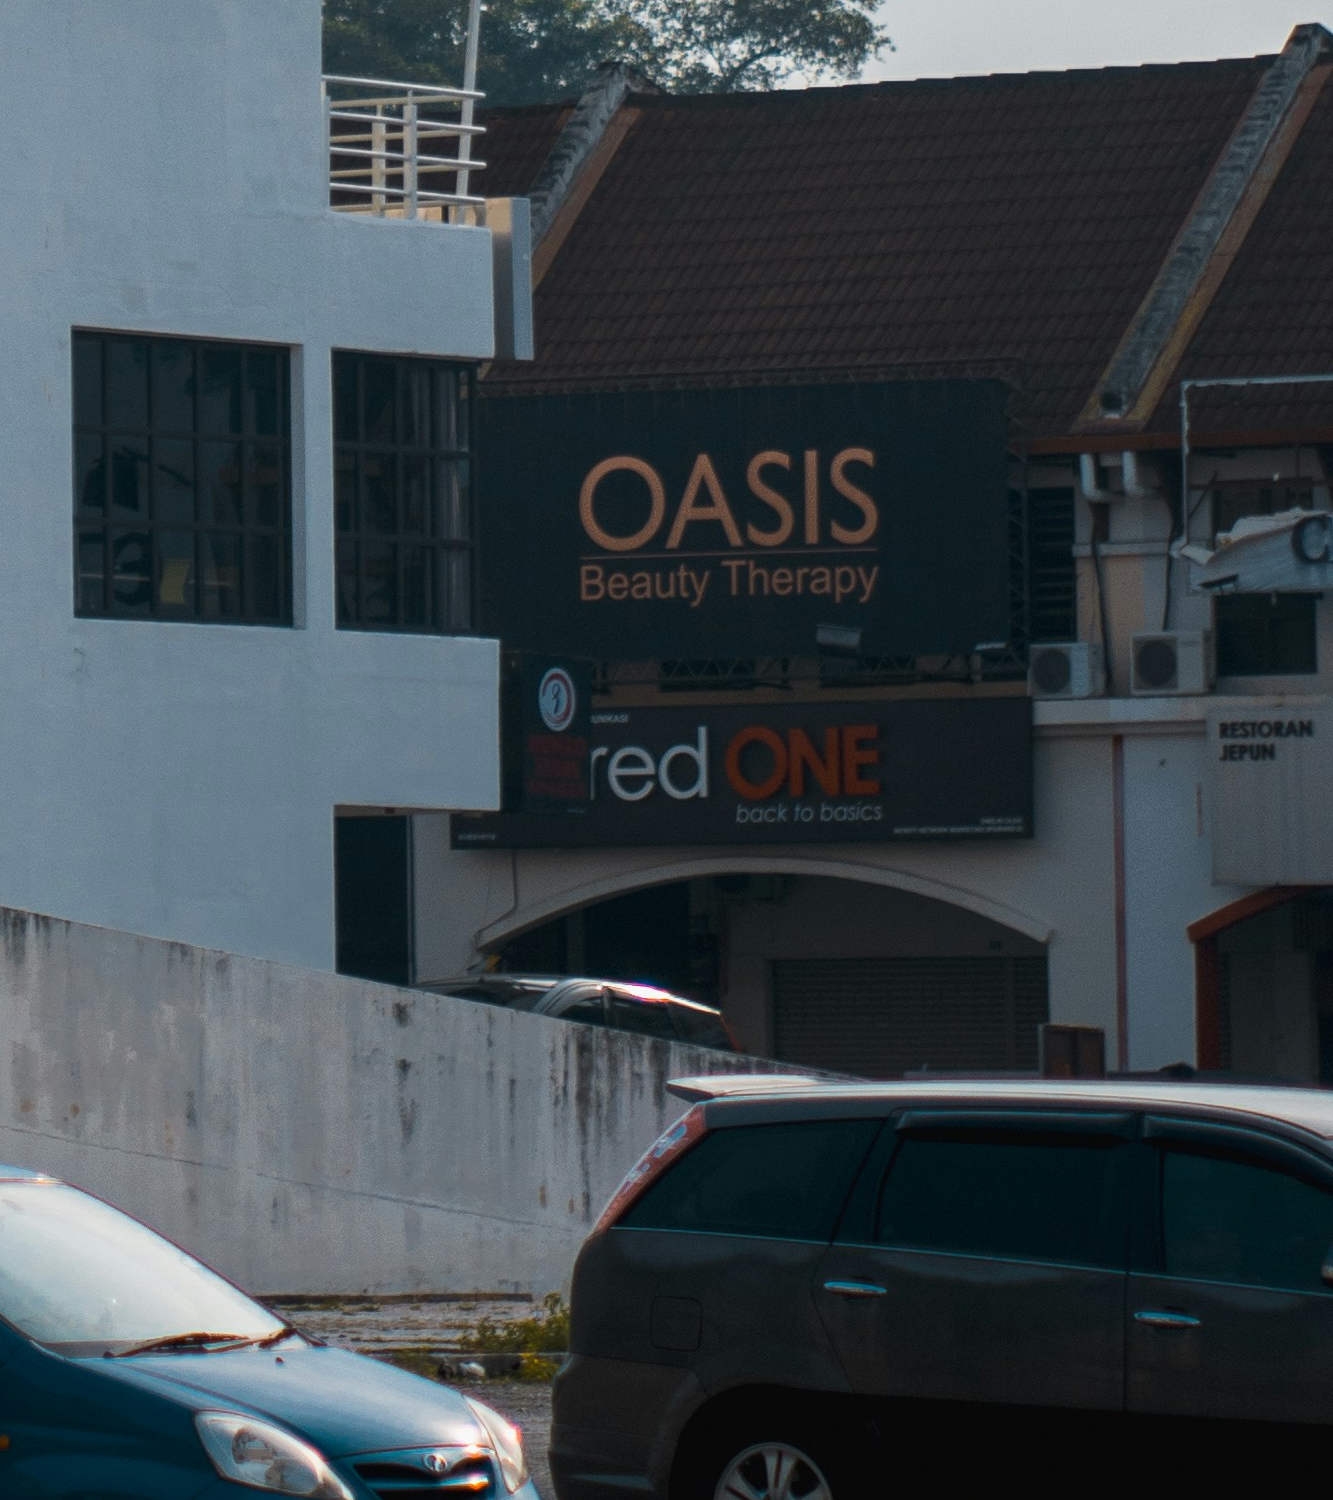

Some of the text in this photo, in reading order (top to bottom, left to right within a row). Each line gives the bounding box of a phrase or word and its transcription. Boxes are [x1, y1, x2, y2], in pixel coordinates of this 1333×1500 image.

[579, 448, 879, 551] OASIS
[580, 560, 879, 607] Beauty Therapy
[1219, 719, 1314, 740] RESTORAN
[590, 726, 708, 801] red
[725, 724, 881, 801] ONE
[1219, 743, 1276, 762] JEPUN
[735, 801, 882, 824] back to basics
